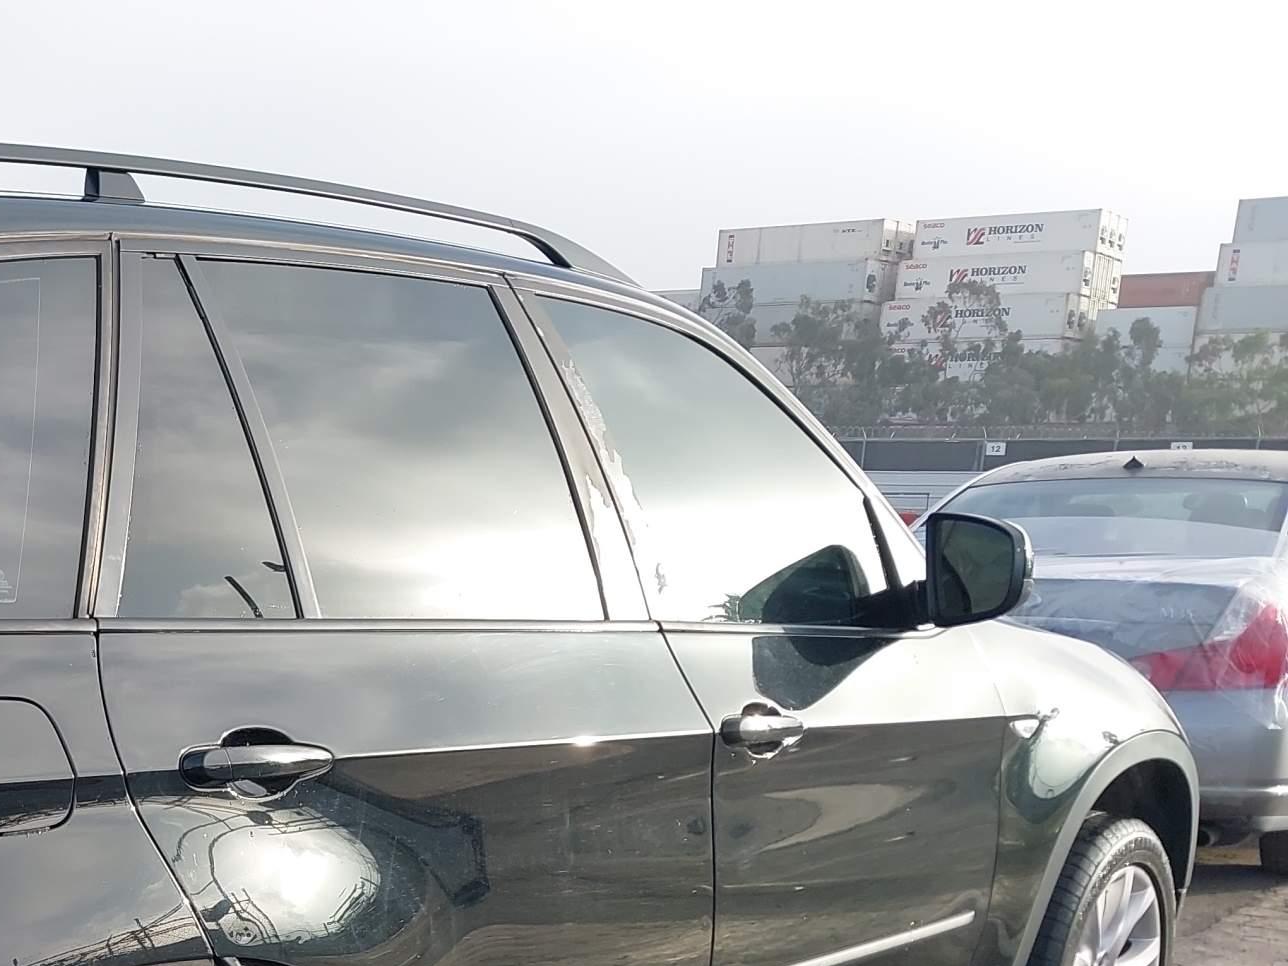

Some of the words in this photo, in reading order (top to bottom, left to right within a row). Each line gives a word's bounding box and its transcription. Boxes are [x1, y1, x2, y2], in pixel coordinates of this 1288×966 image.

[988, 223, 1044, 235] HORIZON
[986, 234, 1035, 242] LINES
[970, 265, 1027, 277] HORIZON
[954, 307, 1011, 319] HORIZON
[991, 445, 1001, 453] 12
